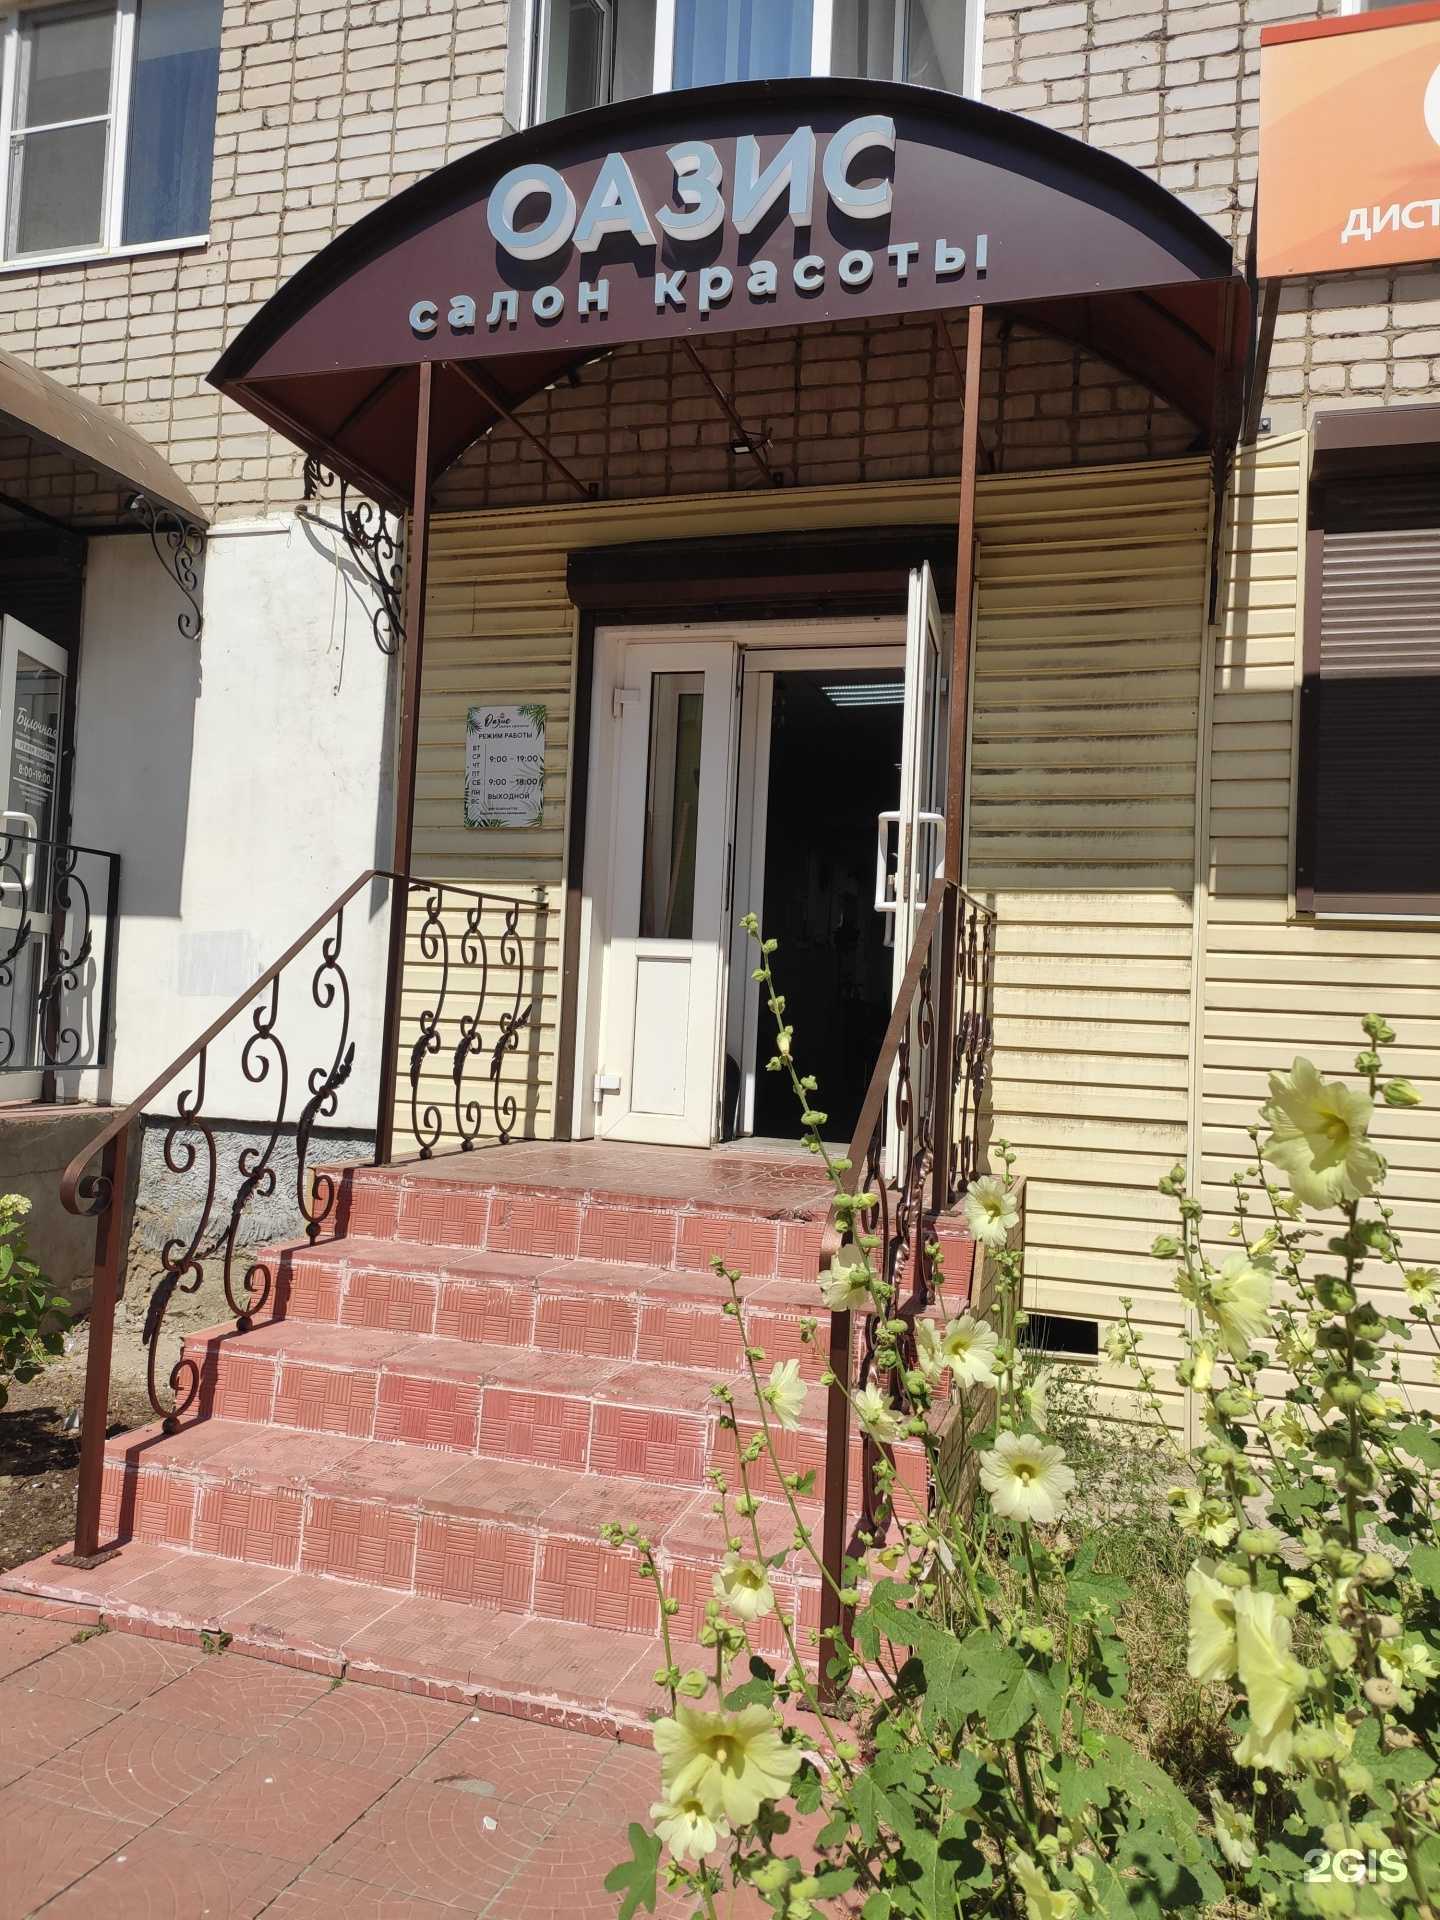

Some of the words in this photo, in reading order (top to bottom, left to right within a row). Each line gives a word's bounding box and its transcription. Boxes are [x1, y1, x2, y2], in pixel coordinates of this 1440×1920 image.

[487, 114, 897, 261] ОАЗИС
[1340, 198, 1440, 245] ДИСТ
[408, 277, 610, 334] салон
[654, 234, 989, 312] красоты
[489, 755, 508, 763] 9:00
[516, 754, 539, 762] 19:00
[18, 763, 51, 785] 8:00-19:00
[488, 778, 507, 786] 9:00
[515, 778, 538, 786] 18:00
[487, 791, 530, 800] ВЫХОДНОЙ
